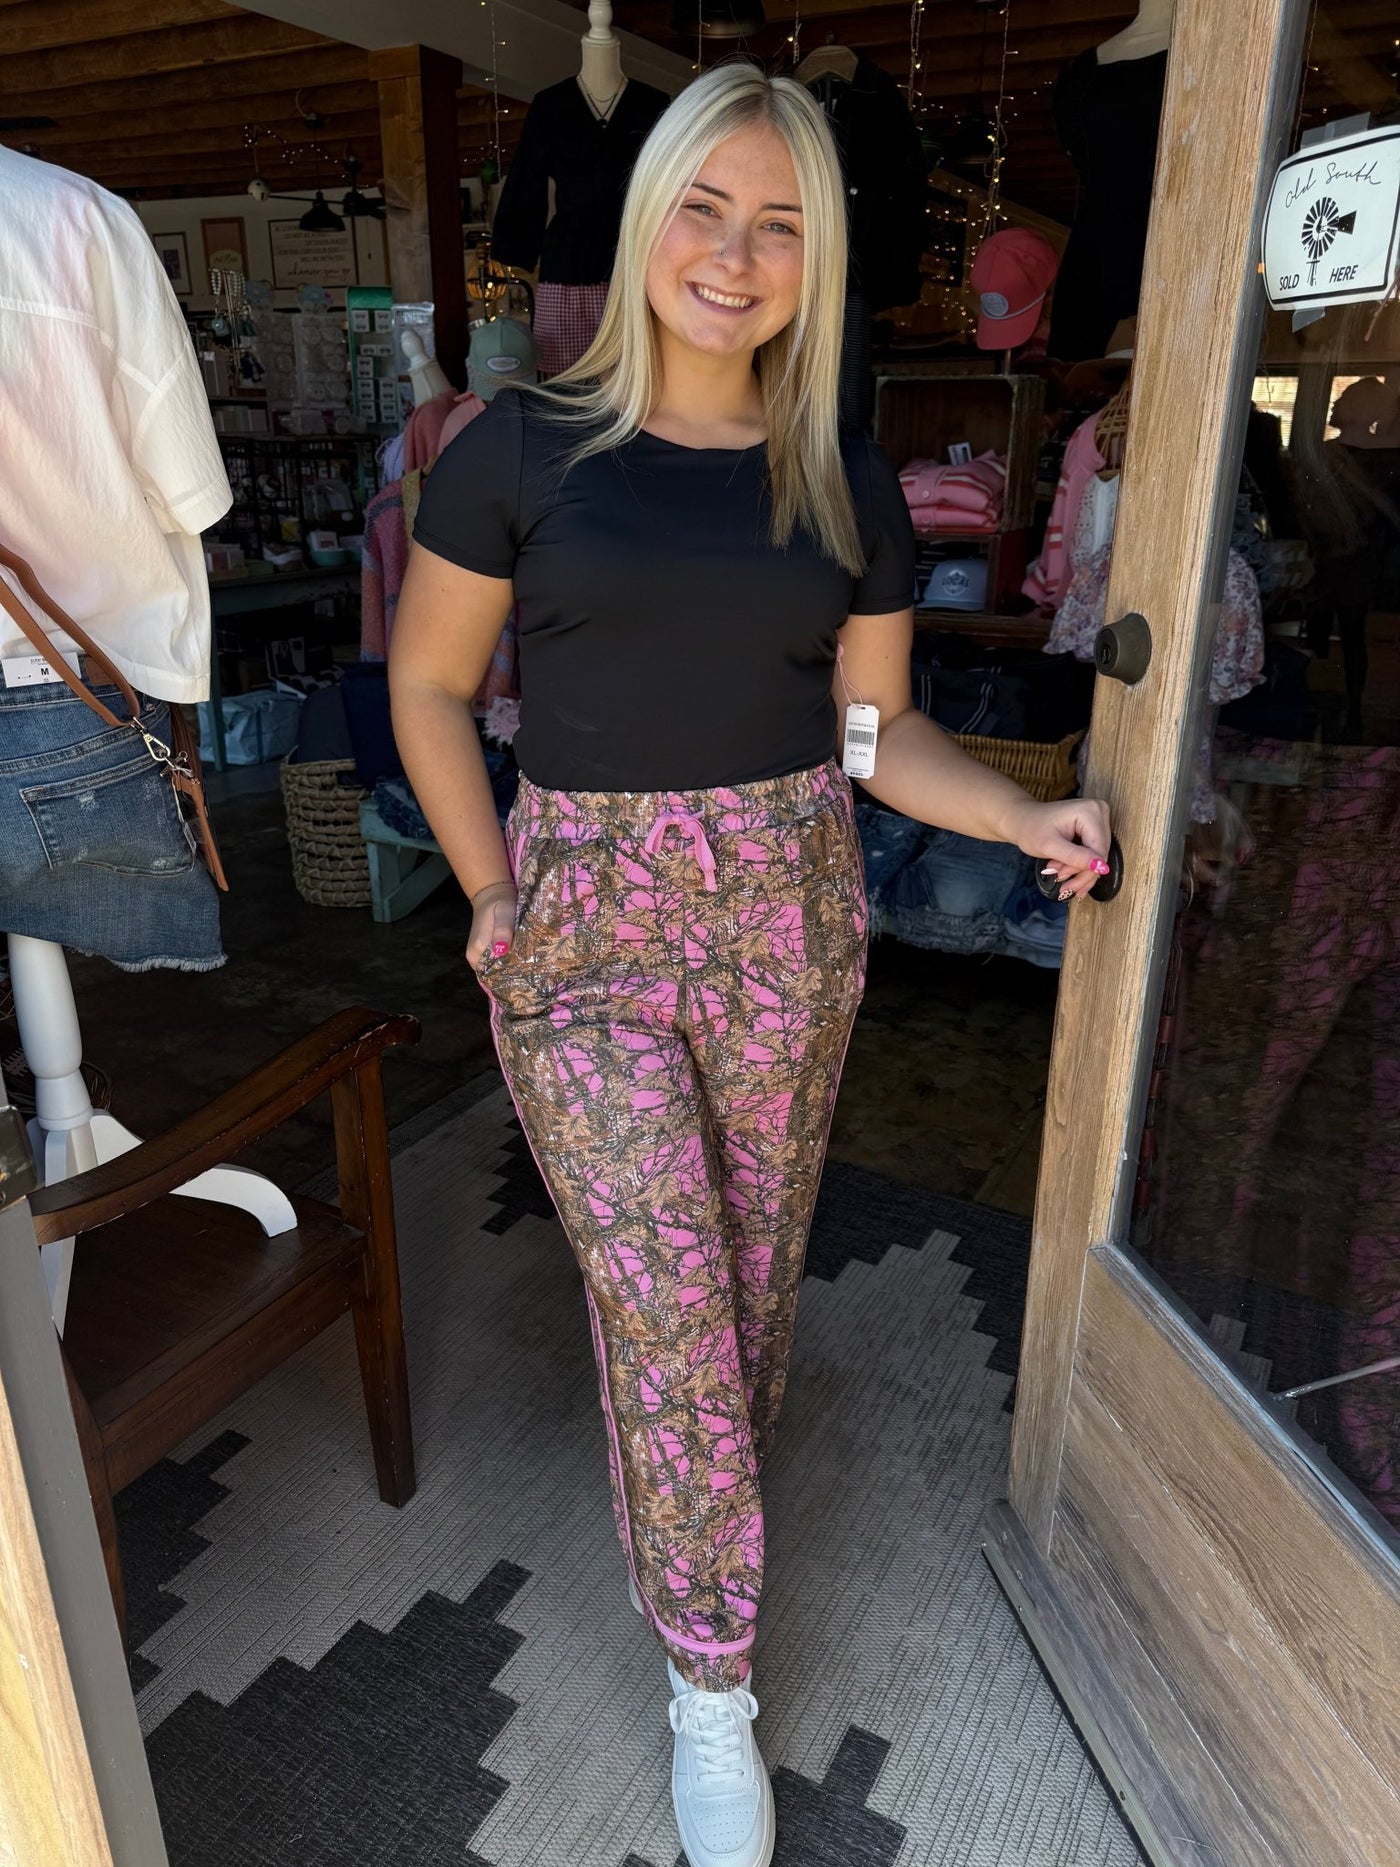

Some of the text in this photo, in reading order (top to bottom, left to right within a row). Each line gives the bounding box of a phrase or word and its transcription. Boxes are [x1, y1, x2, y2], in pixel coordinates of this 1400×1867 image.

[1325, 161, 1382, 185] South
[1279, 264, 1359, 291] SOLD HERE
[41, 667, 49, 676] M
